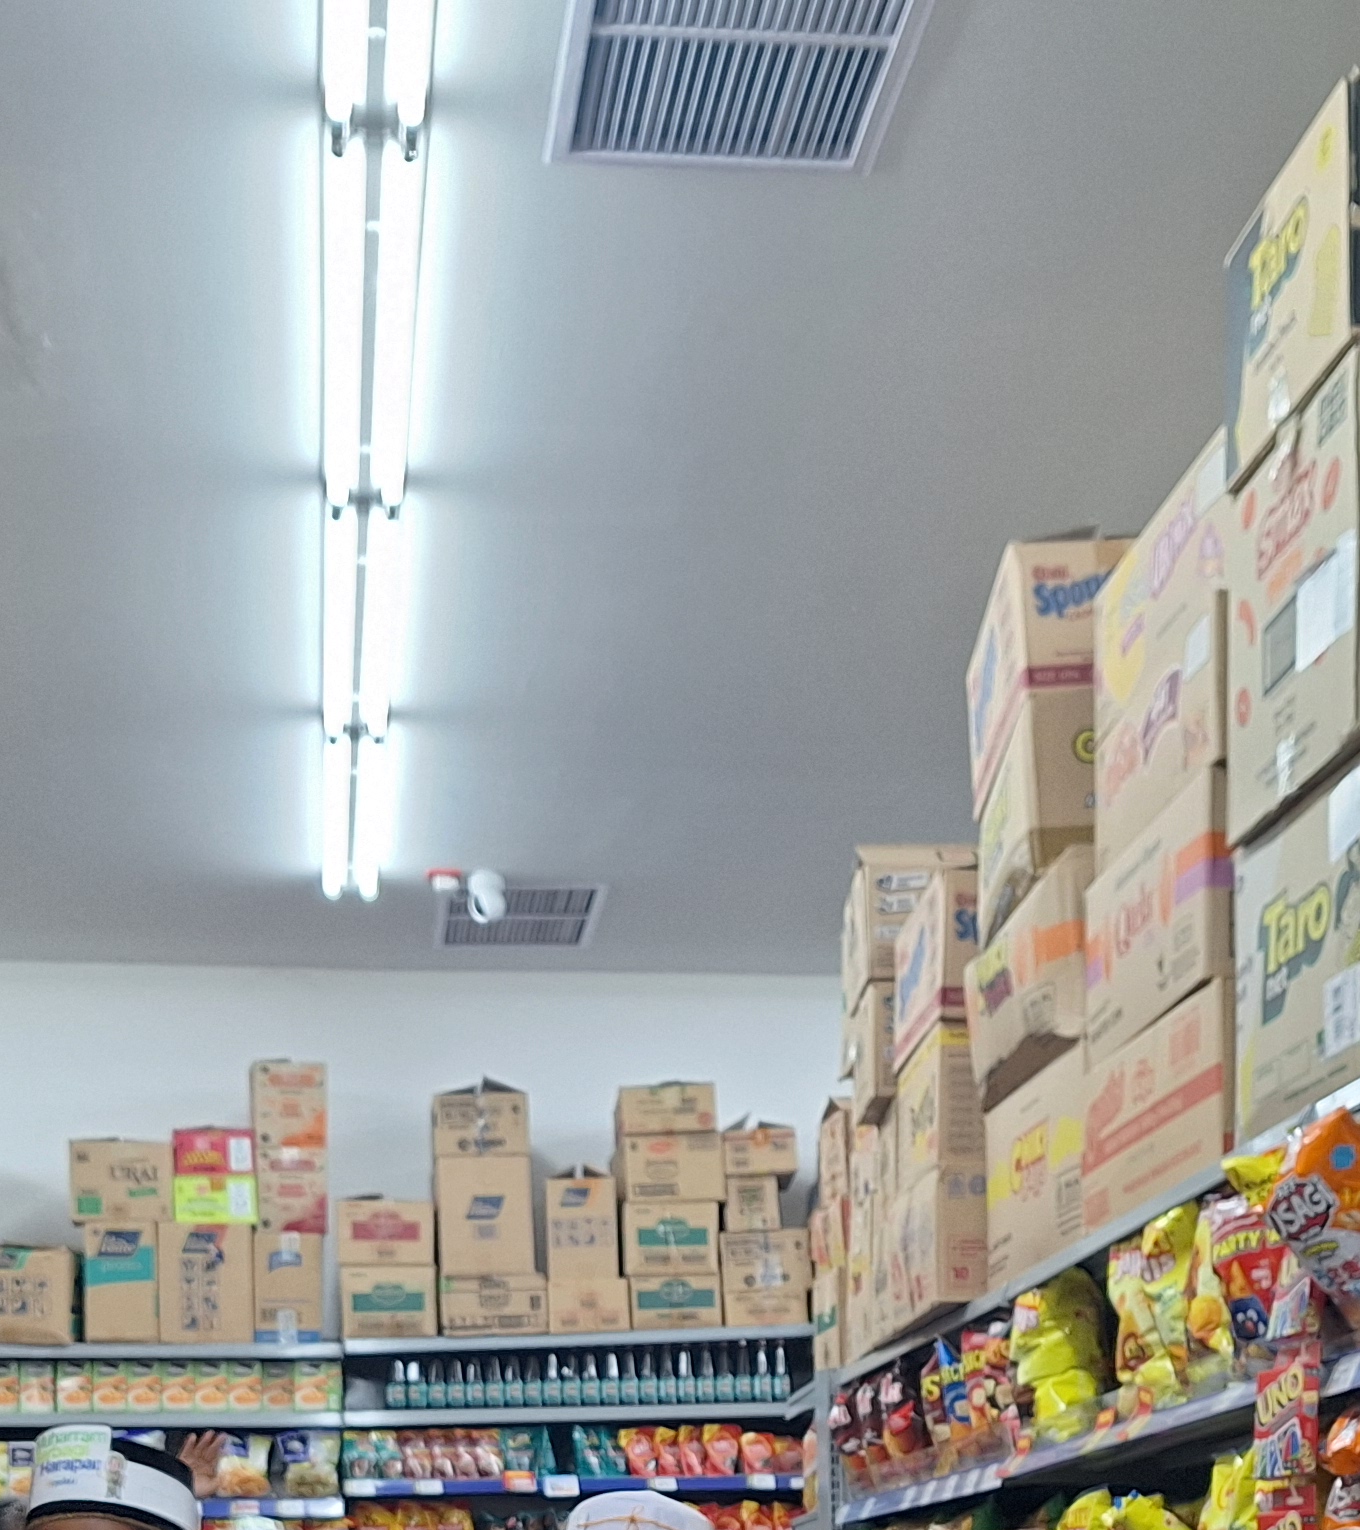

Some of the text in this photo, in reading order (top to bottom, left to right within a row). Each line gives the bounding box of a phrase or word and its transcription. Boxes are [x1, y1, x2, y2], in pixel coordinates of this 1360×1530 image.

[1034, 567, 1112, 620] Spon
[1261, 881, 1331, 974] Taro
[1256, 1364, 1305, 1427] UNO
